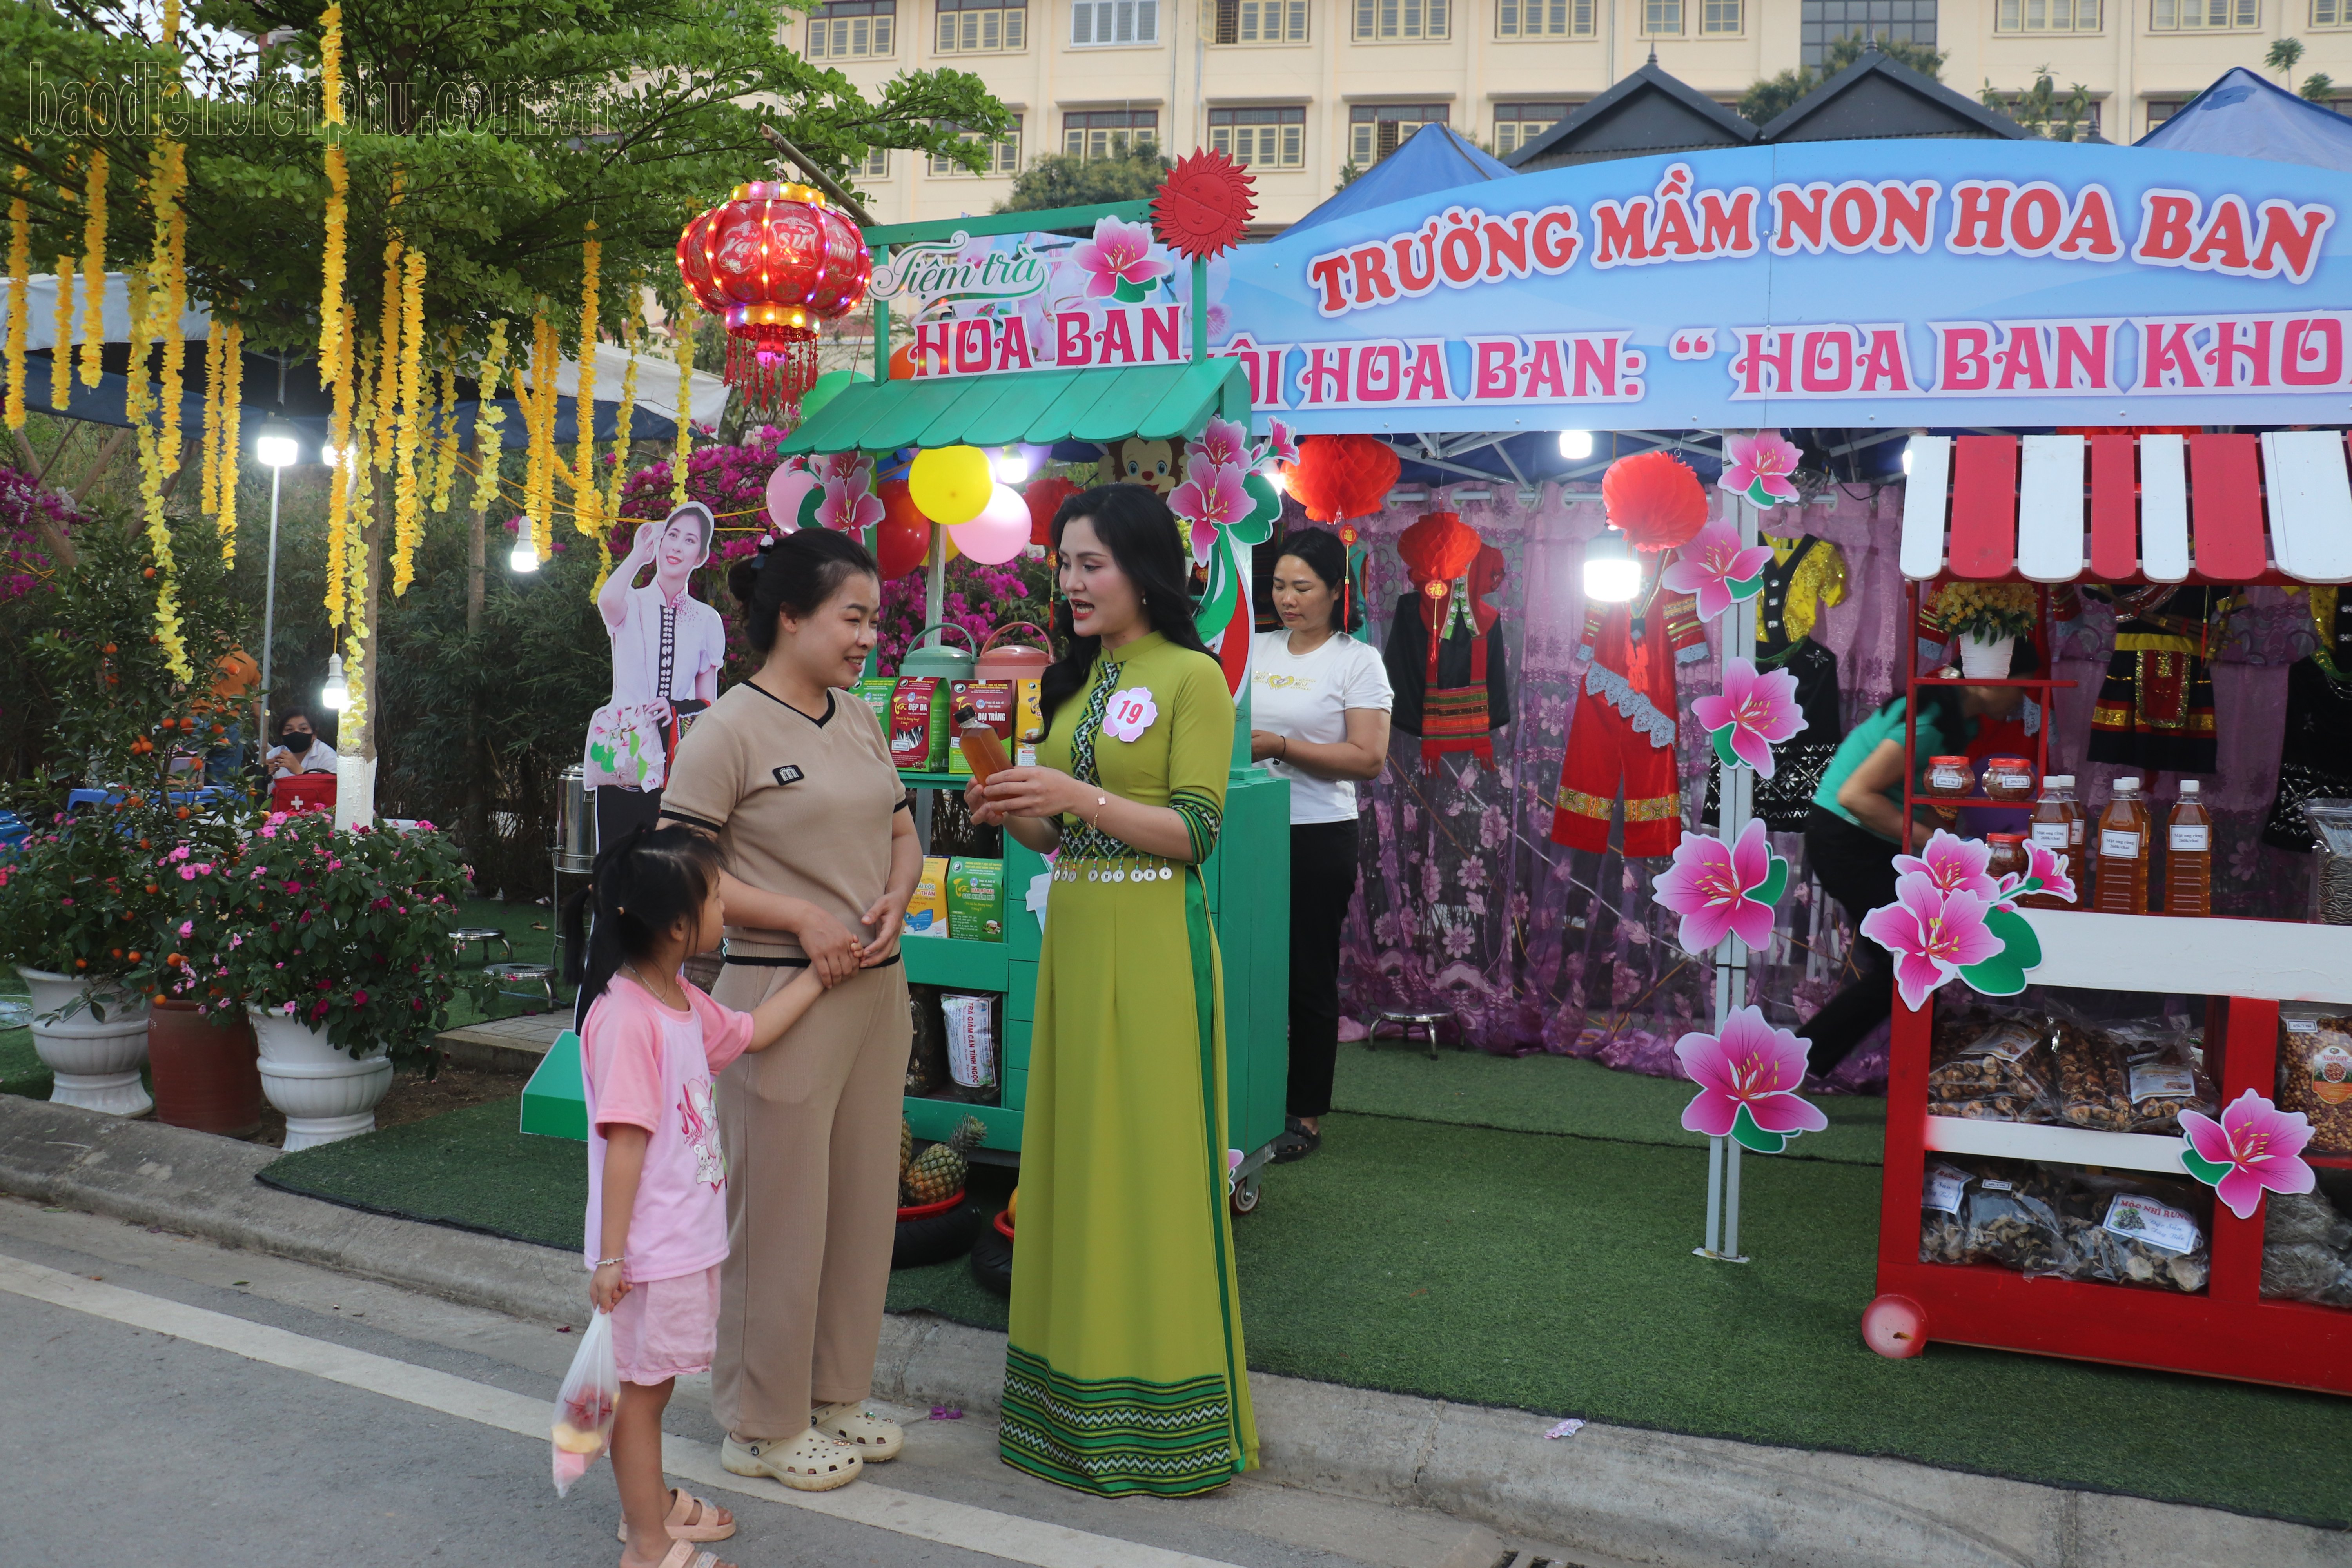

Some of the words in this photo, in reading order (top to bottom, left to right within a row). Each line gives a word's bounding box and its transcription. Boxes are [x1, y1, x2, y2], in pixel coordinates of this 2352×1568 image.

[1313, 210, 1577, 312] TRƯỜNG
[1596, 169, 1754, 257] MẦM
[1777, 186, 1934, 250] NON
[1958, 187, 2118, 256] HOA
[2139, 195, 2327, 277] BAN
[870, 232, 977, 300] Tiệm
[982, 247, 1045, 286] trà
[910, 315, 1033, 377] HOA
[1056, 305, 1181, 367] BAN
[1301, 340, 1449, 403] HOA
[1474, 337, 1640, 400] BAN:
[1736, 328, 1910, 393] HOA
[1943, 325, 2111, 391] BAN
[2142, 318, 2352, 389] KHO
[1429, 583, 1442, 596] 福
[908, 703, 919, 712] ĐẸP
[1117, 700, 1143, 724] 19
[978, 713, 987, 722] ĐẠI
[988, 711, 1005, 721] TRÀNG
[967, 1017, 976, 1033] GIẢM
[971, 1066, 979, 1083] NGỌC
[2120, 1200, 2141, 1209] MỘC
